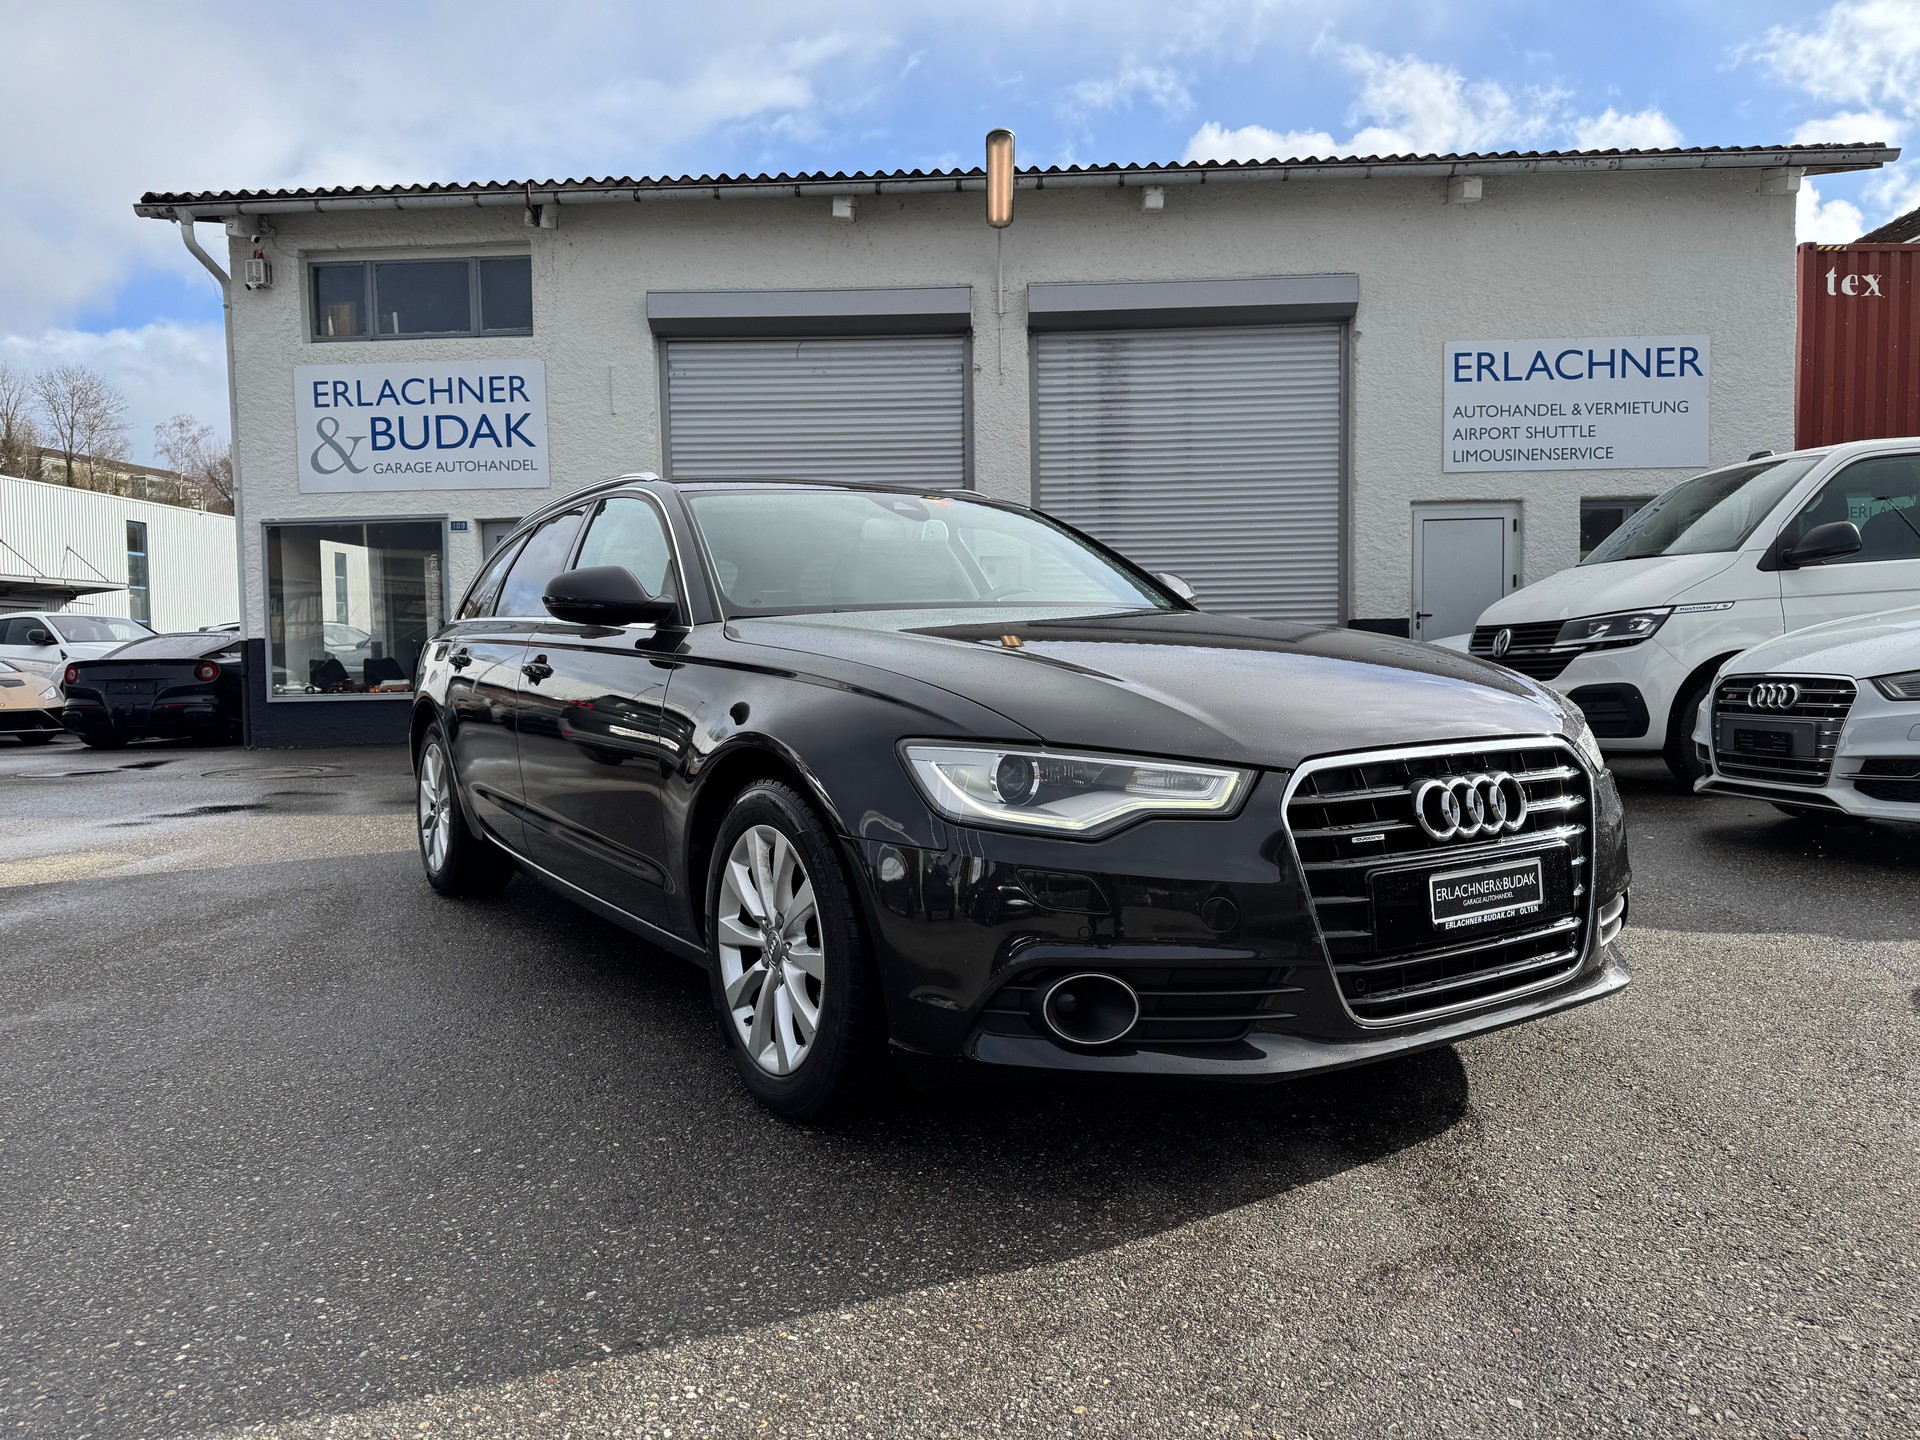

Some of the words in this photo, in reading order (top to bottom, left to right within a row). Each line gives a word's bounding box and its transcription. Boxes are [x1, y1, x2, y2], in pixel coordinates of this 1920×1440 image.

[1825, 265, 1883, 297] tex
[1454, 346, 1704, 383] ERLACHNER
[312, 375, 531, 408] ERLACHNER
[1452, 403, 1567, 419] AUTOHANDEL
[1571, 402, 1582, 416] &
[1584, 400, 1689, 416] VERMIETUNG
[310, 416, 368, 475] &
[370, 412, 537, 451] BUDAK
[1452, 426, 1521, 441] AIRPORT
[1525, 425, 1597, 439] SHUTTLE
[1453, 446, 1614, 463] LIMOUSINENSERVICE
[372, 460, 433, 474] GARAGE
[434, 459, 538, 473] AUTOHANDEL
[452, 522, 466, 530] 109
[1435, 871, 1537, 902] ERLACHNER&BUDAK
[1462, 897, 1483, 907] GARAGE
[1482, 891, 1514, 903] AUTOHANDEL
[1444, 909, 1516, 930] ERLACHNER-BUDAK.CH
[1519, 904, 1539, 915] OLTEN
